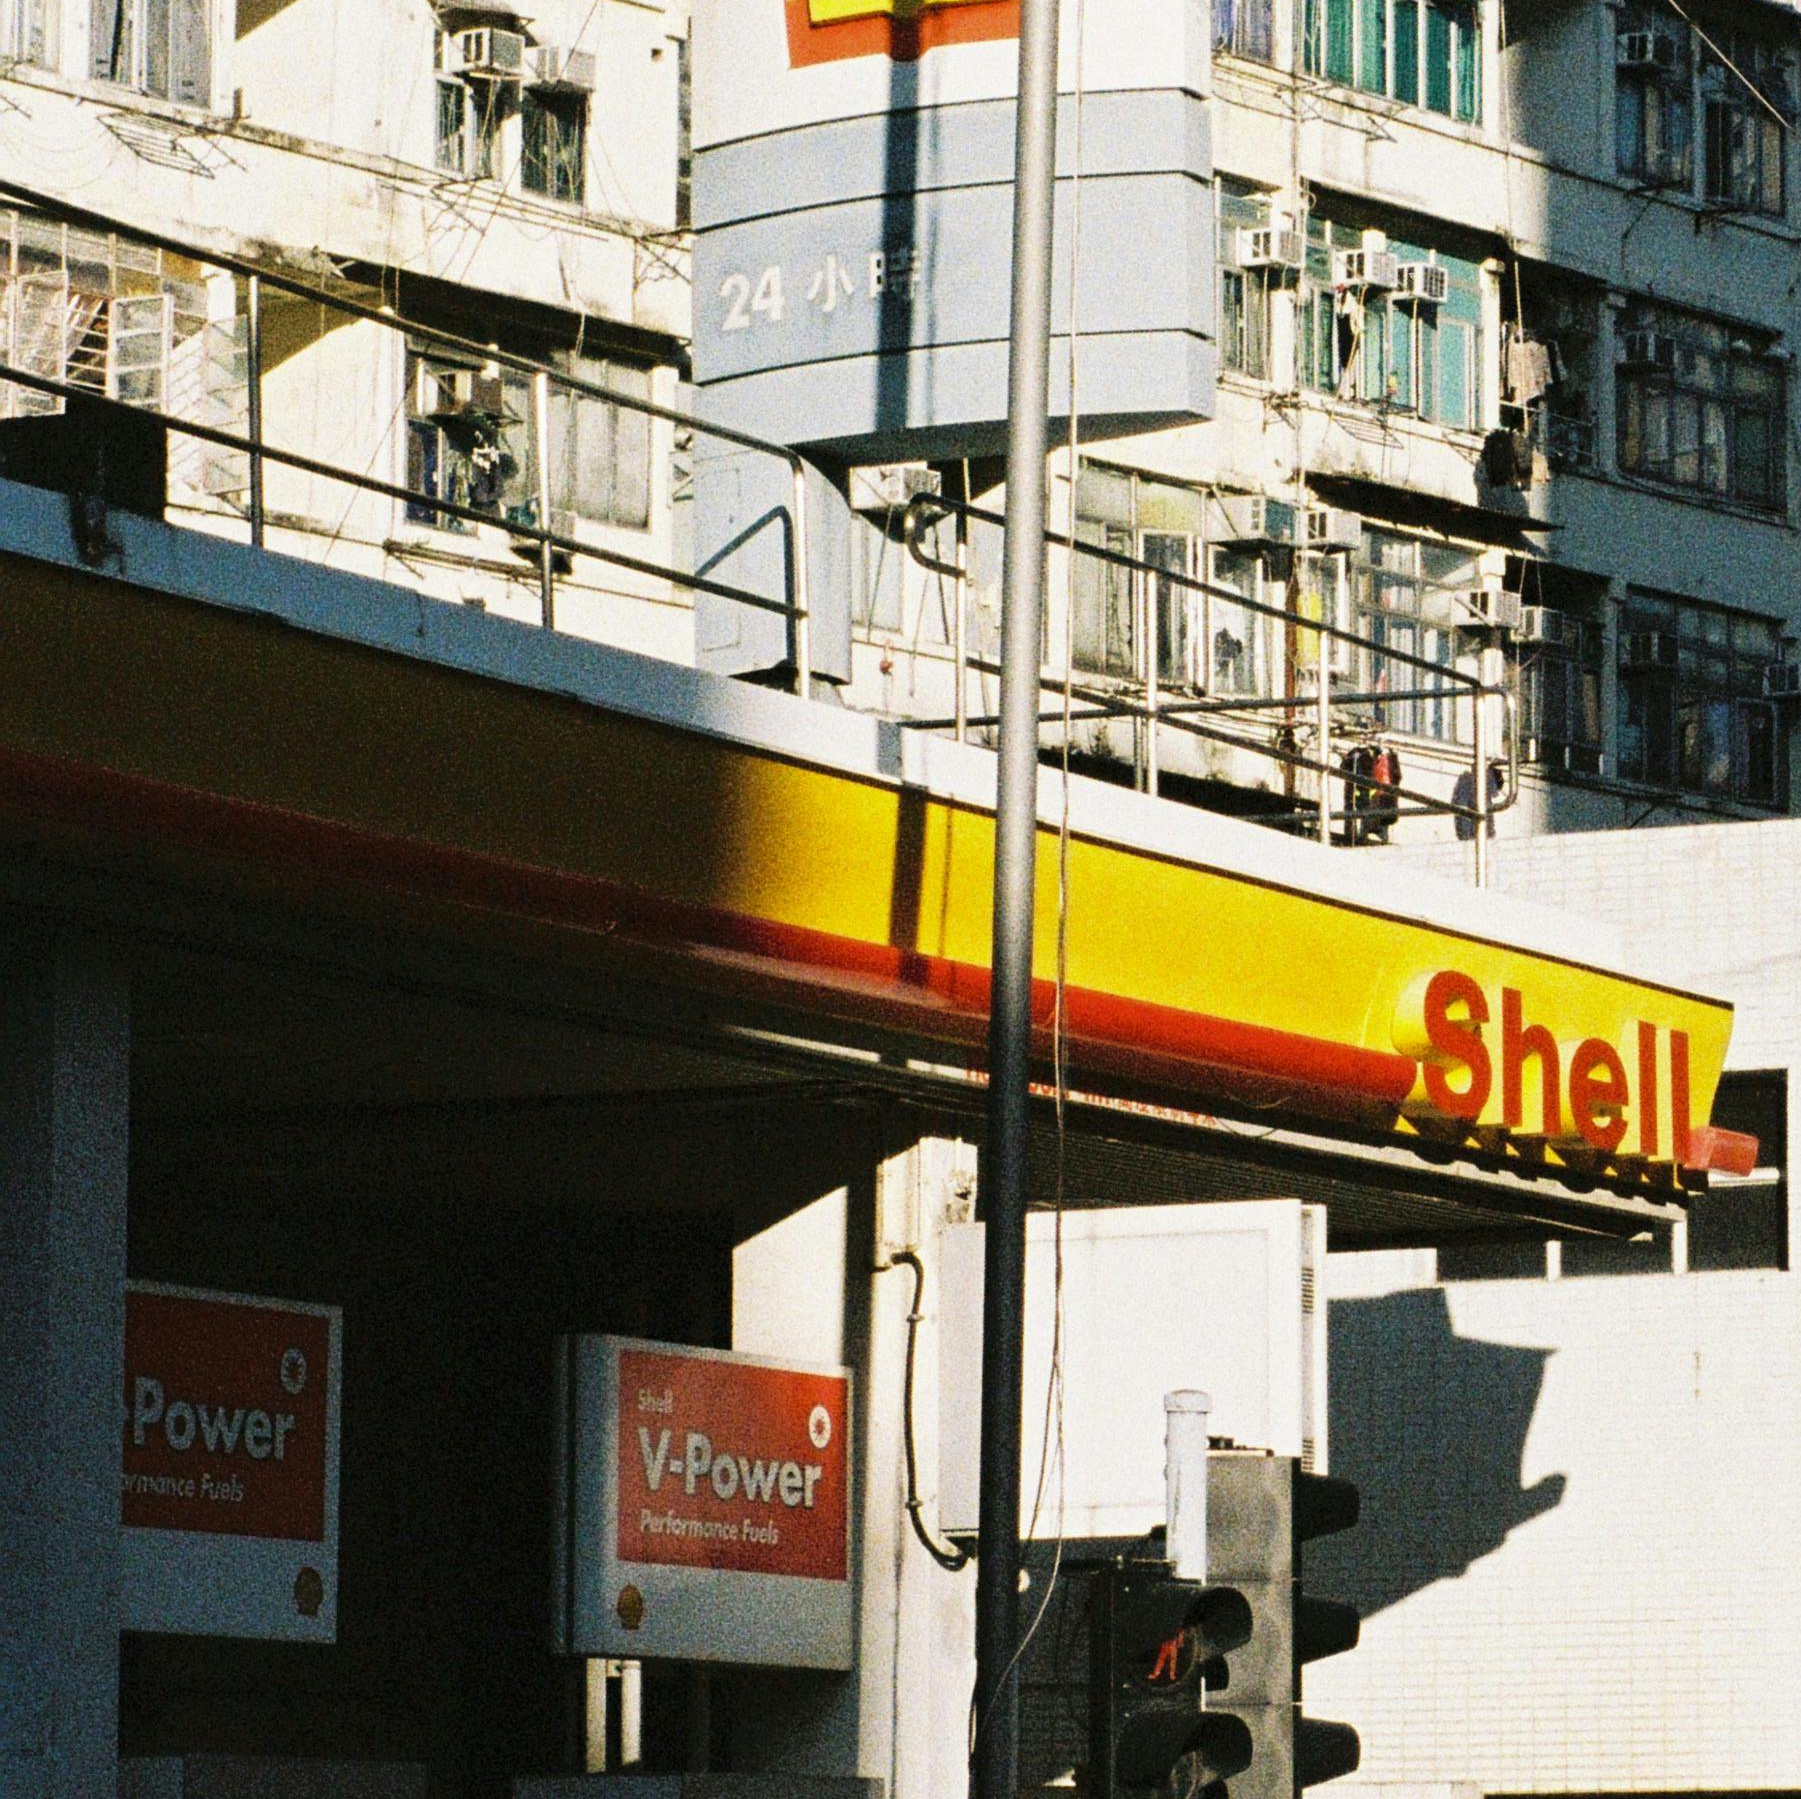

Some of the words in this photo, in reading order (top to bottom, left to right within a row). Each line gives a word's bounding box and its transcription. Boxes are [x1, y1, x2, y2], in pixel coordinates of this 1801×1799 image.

[718, 266, 787, 332] 24
[1422, 969, 1692, 1163] Shell
[127, 1374, 297, 1462] Power
[637, 1426, 824, 1509] V-Power
[639, 1508, 739, 1541] Performance
[740, 1517, 781, 1546] Fuels
